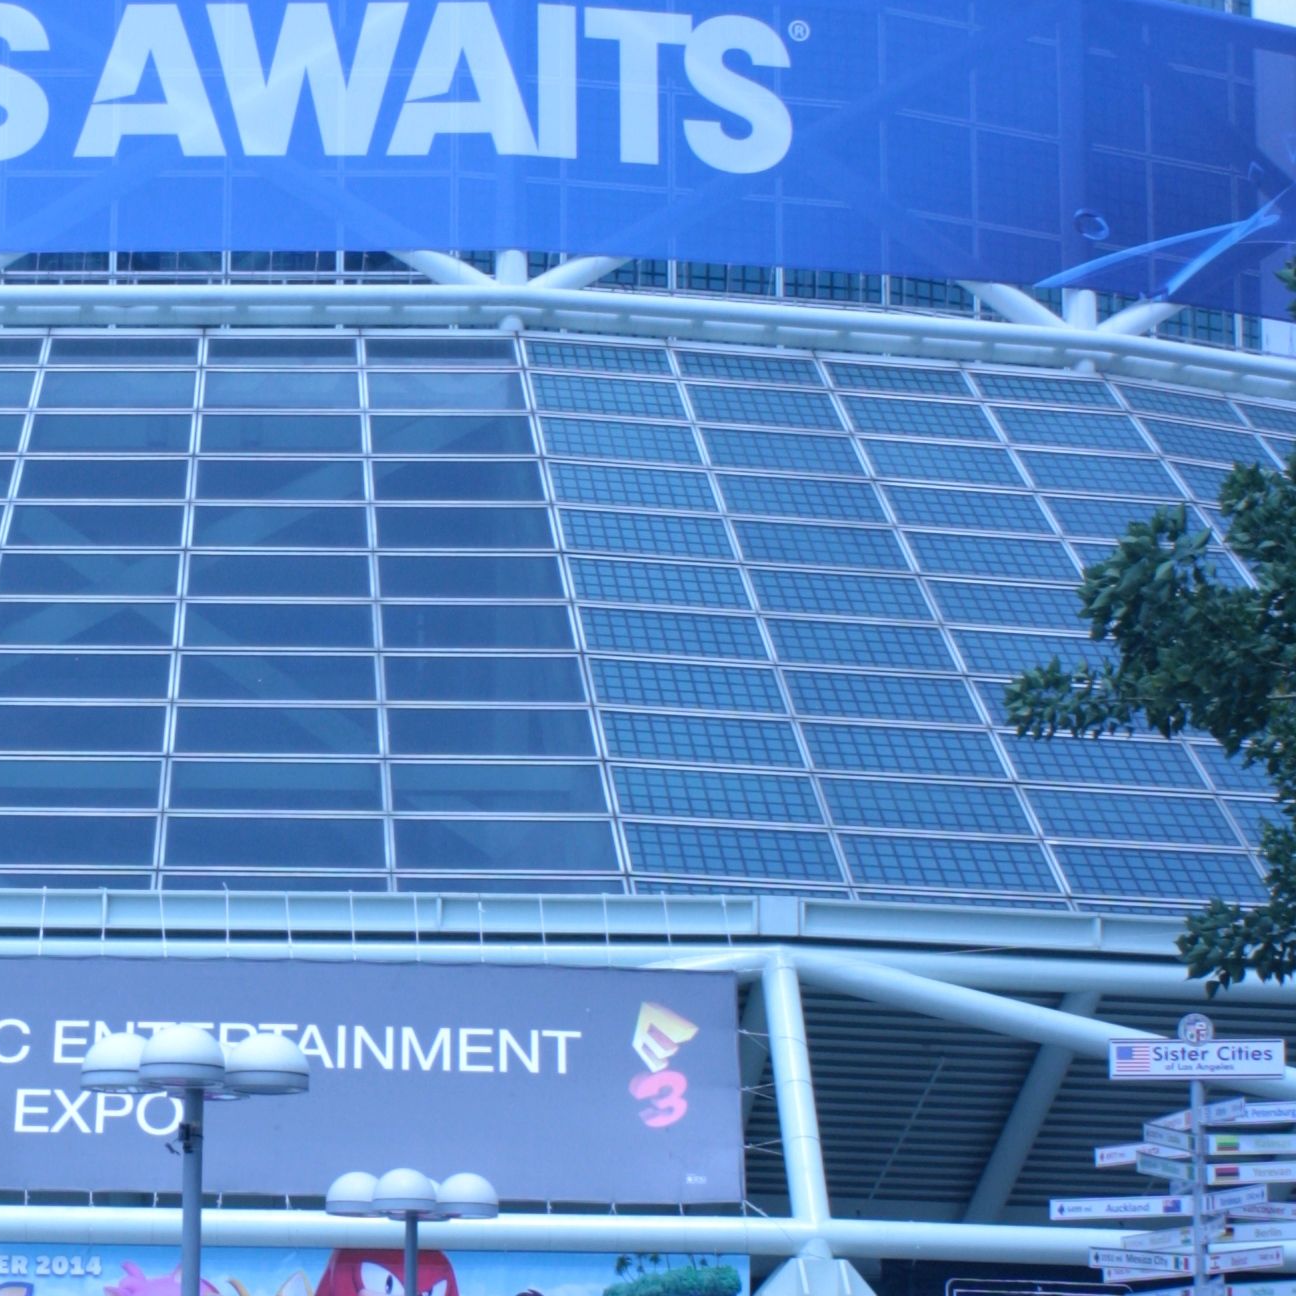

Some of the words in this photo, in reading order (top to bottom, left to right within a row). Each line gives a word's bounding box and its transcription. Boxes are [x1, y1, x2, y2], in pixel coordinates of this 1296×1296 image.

[72, 1, 794, 175] AWAITS
[1152, 1046, 1209, 1062] Sister
[1216, 1046, 1274, 1062] Cities
[1165, 1063, 1175, 1071] of
[1177, 1063, 1193, 1071] Los
[1196, 1063, 1235, 1073] Angeles
[13, 1087, 185, 1136] EXPO
[1105, 1203, 1151, 1214] Auckland
[1254, 1228, 1282, 1238] Berlin
[35, 1255, 102, 1277] 2014
[1125, 1253, 1153, 1264] Mexico
[1153, 1255, 1168, 1267] City
